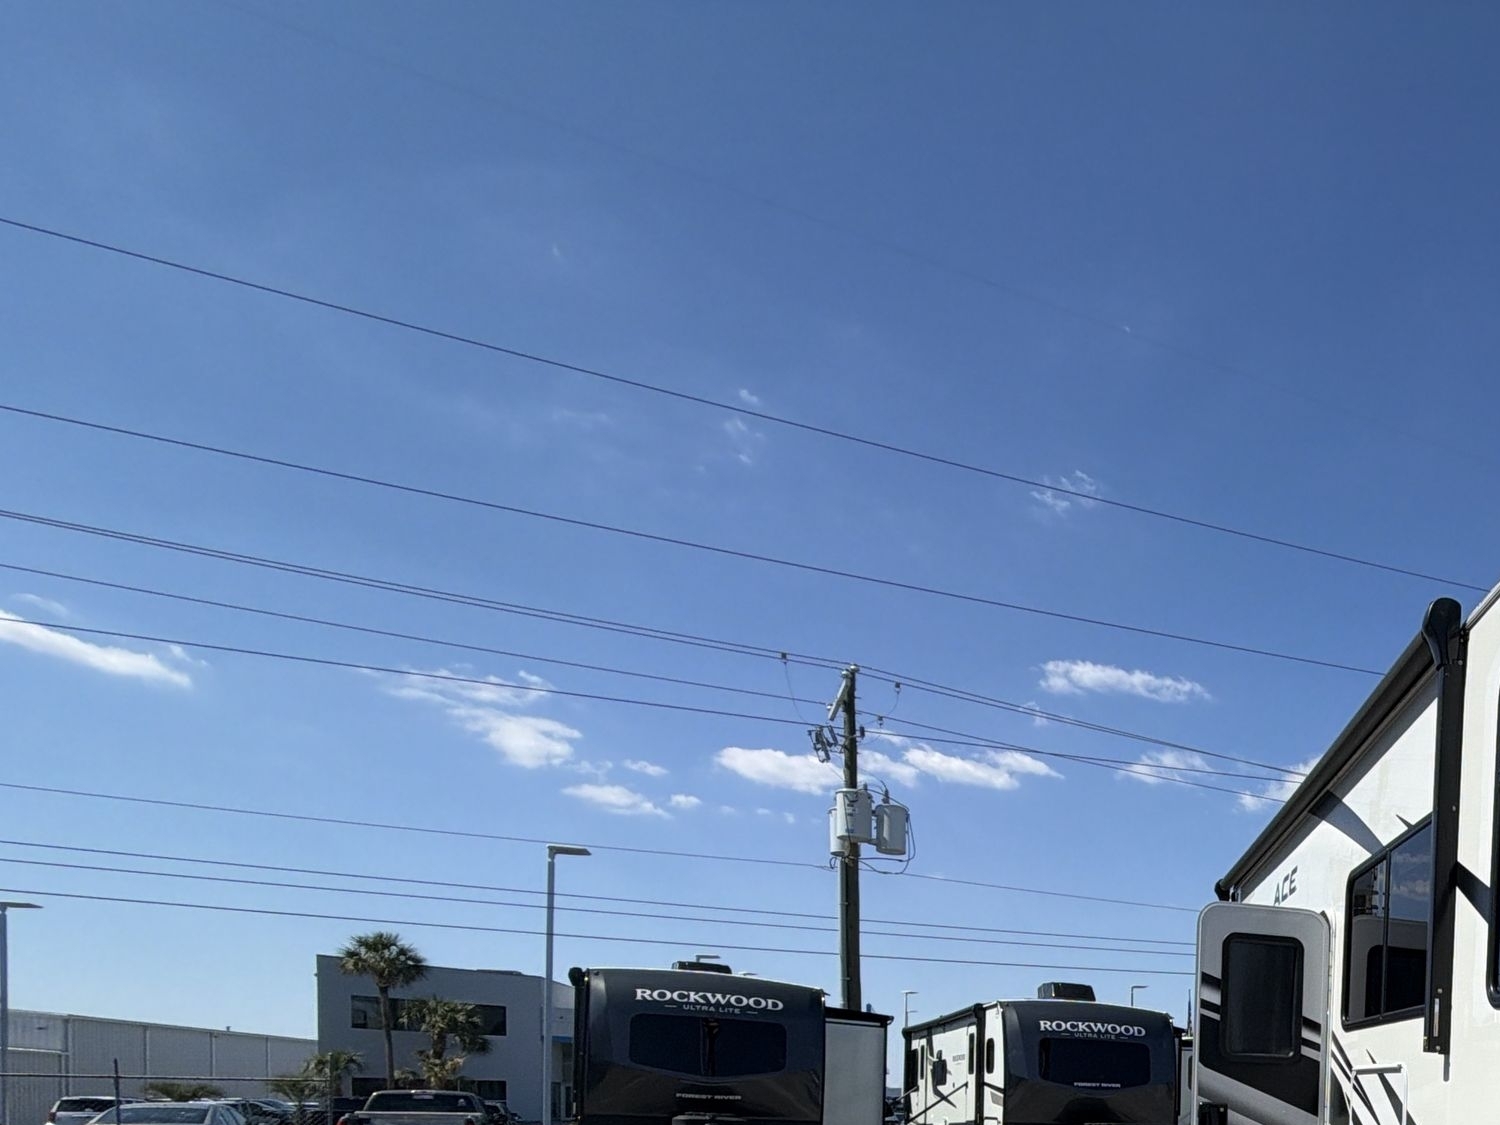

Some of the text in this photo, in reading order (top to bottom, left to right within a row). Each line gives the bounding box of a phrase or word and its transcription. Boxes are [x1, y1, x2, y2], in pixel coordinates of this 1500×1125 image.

[635, 988, 784, 1011] ROCKWOOD
[682, 1004, 716, 1012] ULTRA
[1039, 1020, 1146, 1037] ROCKWOOD
